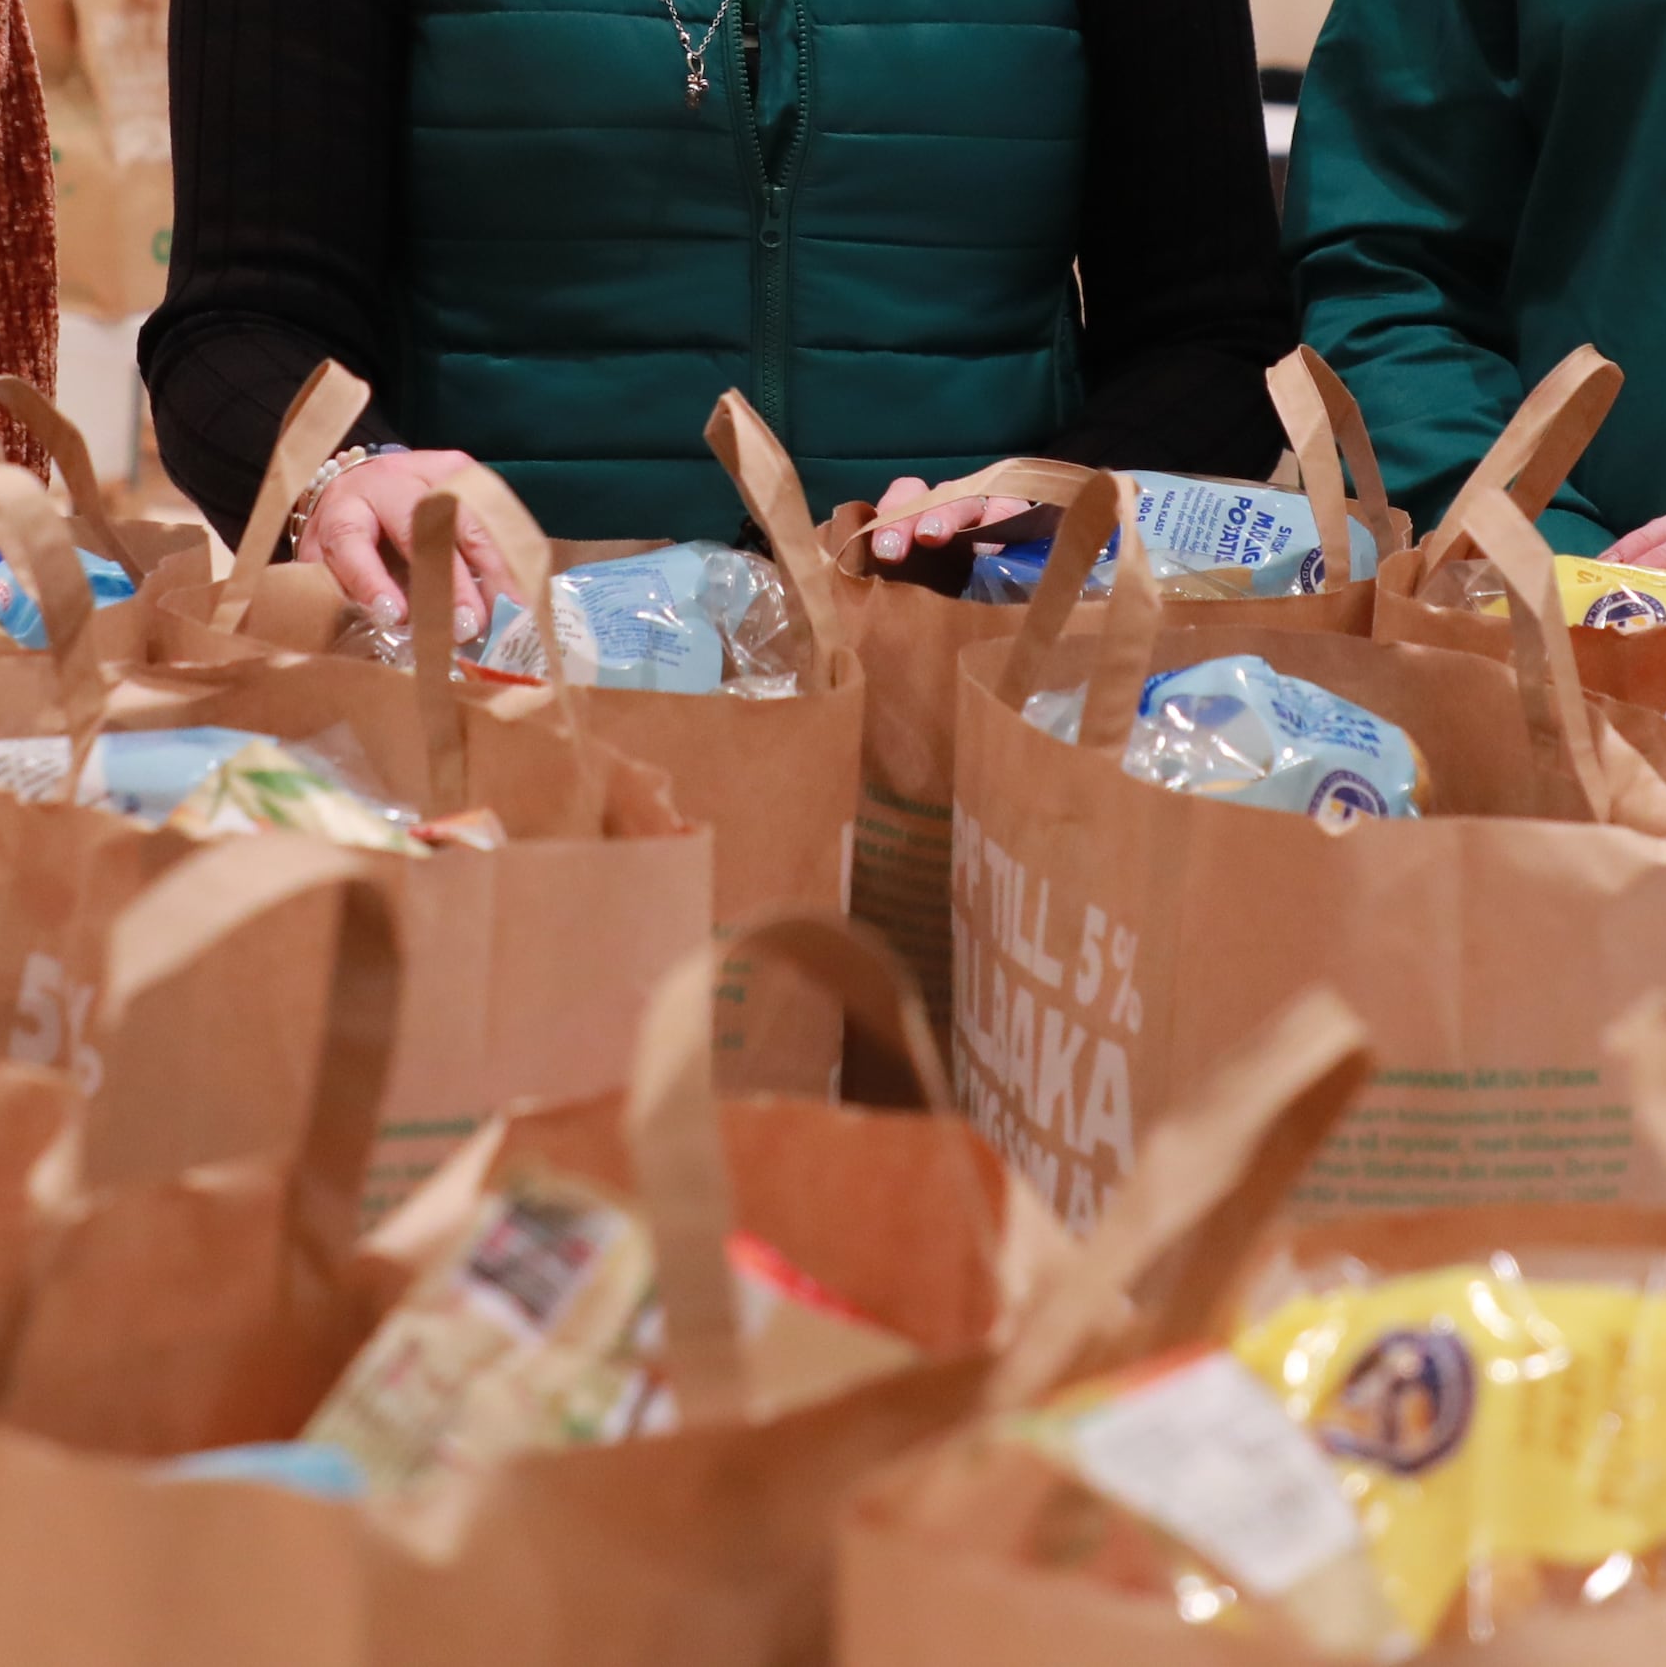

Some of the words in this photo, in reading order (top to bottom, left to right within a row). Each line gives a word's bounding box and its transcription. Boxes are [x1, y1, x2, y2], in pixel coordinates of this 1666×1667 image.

[1138, 495, 1155, 515] 900
[984, 836, 1065, 990] TILL
[1074, 901, 1143, 1035] 5%
